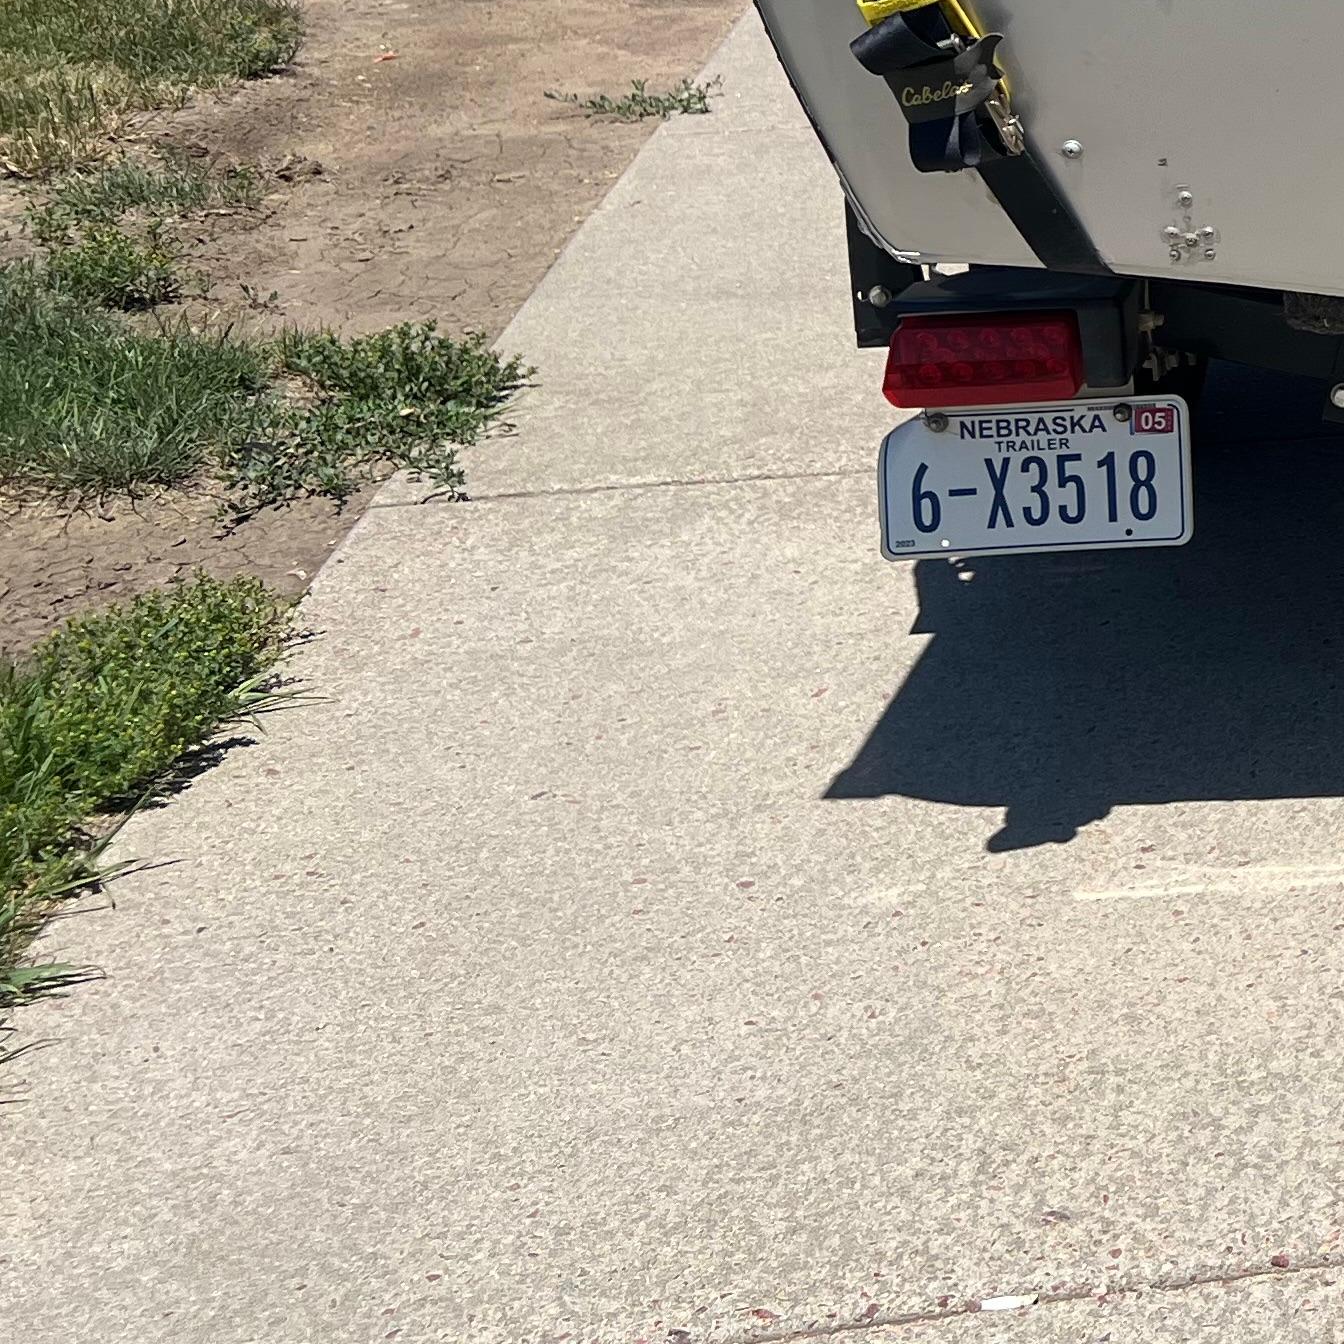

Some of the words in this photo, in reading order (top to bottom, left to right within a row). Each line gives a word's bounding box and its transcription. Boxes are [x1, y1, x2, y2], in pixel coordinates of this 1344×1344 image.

[959, 414, 1108, 440] NEBRASKA
[1141, 412, 1167, 430] 05
[994, 438, 1071, 453] TRAILER
[911, 450, 1158, 534] 6-X3518
